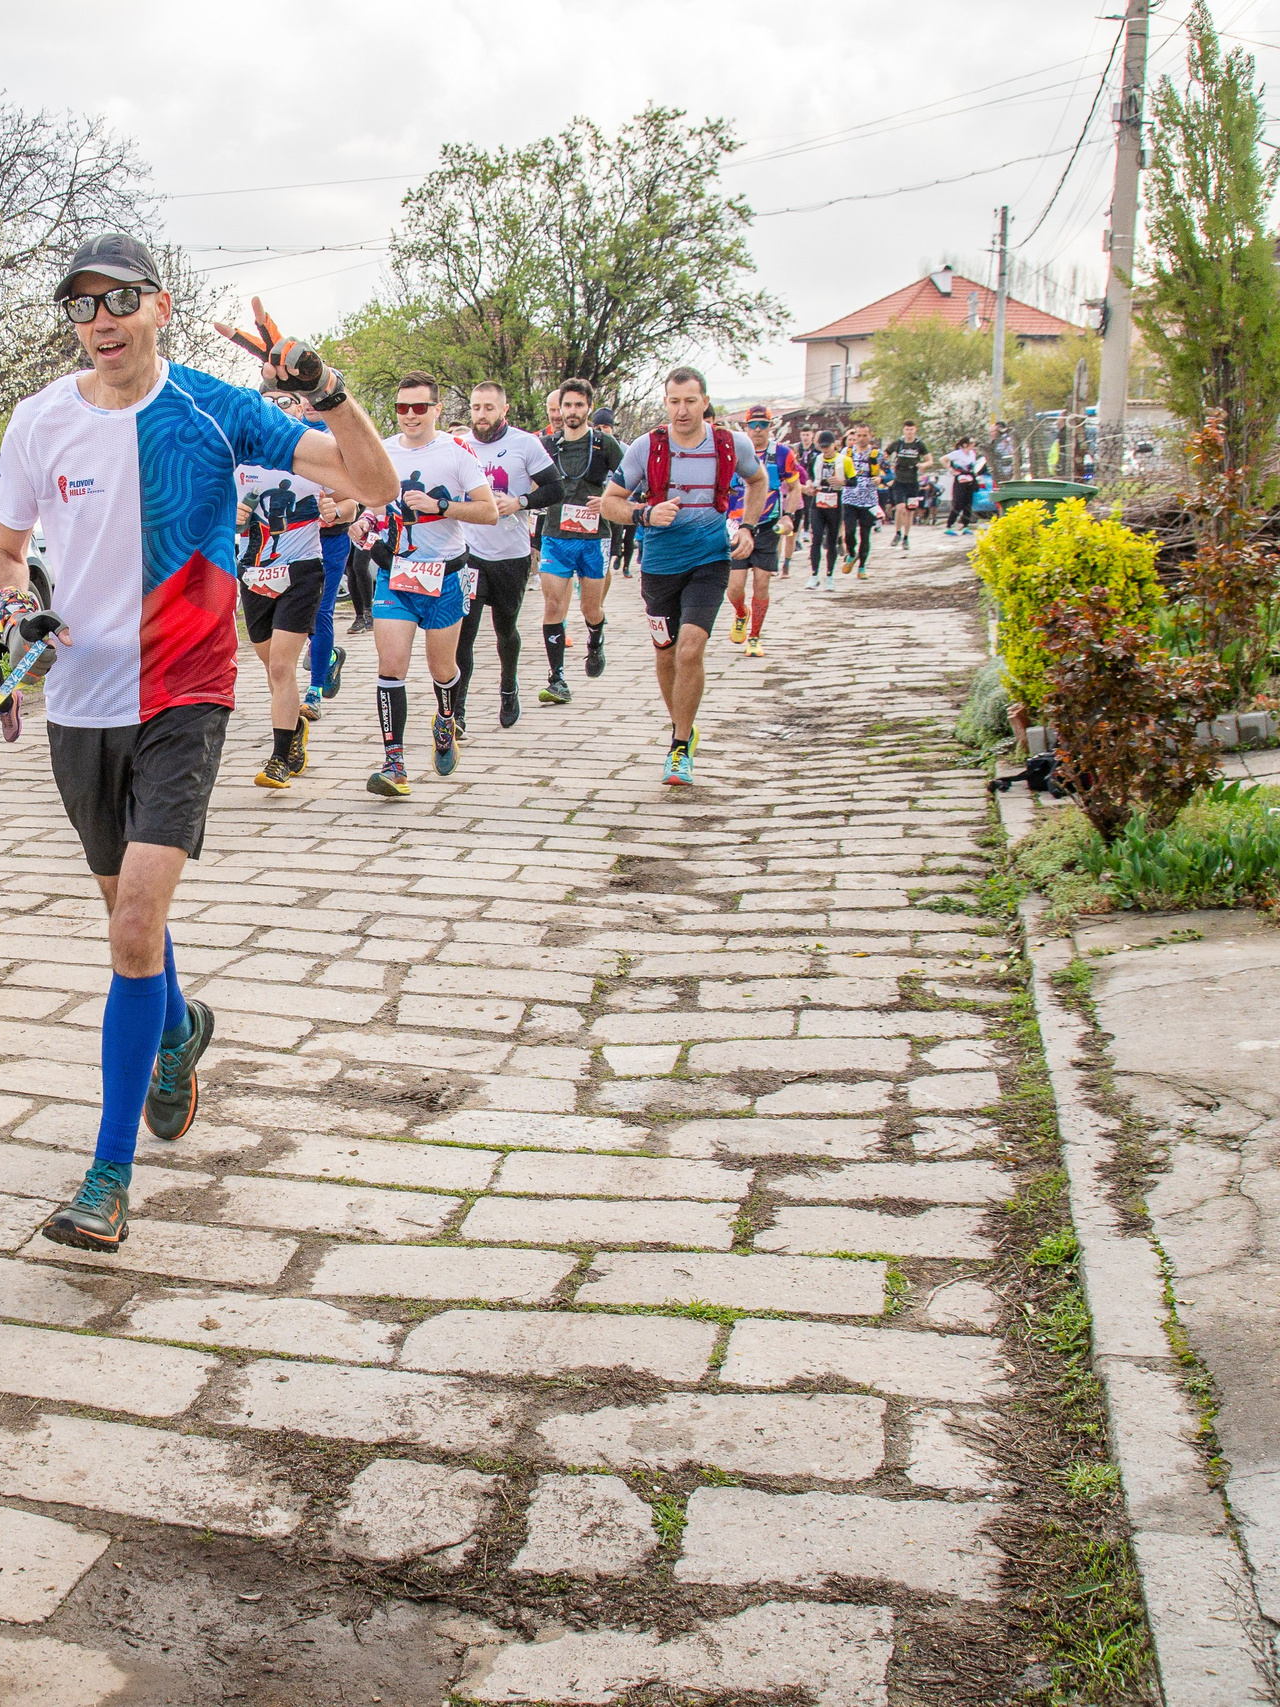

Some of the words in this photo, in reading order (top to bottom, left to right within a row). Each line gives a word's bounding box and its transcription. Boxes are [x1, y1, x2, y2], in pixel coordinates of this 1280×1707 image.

[69, 488, 86, 496] HILLS
[258, 566, 287, 582] 2357
[411, 561, 442, 577] 2442
